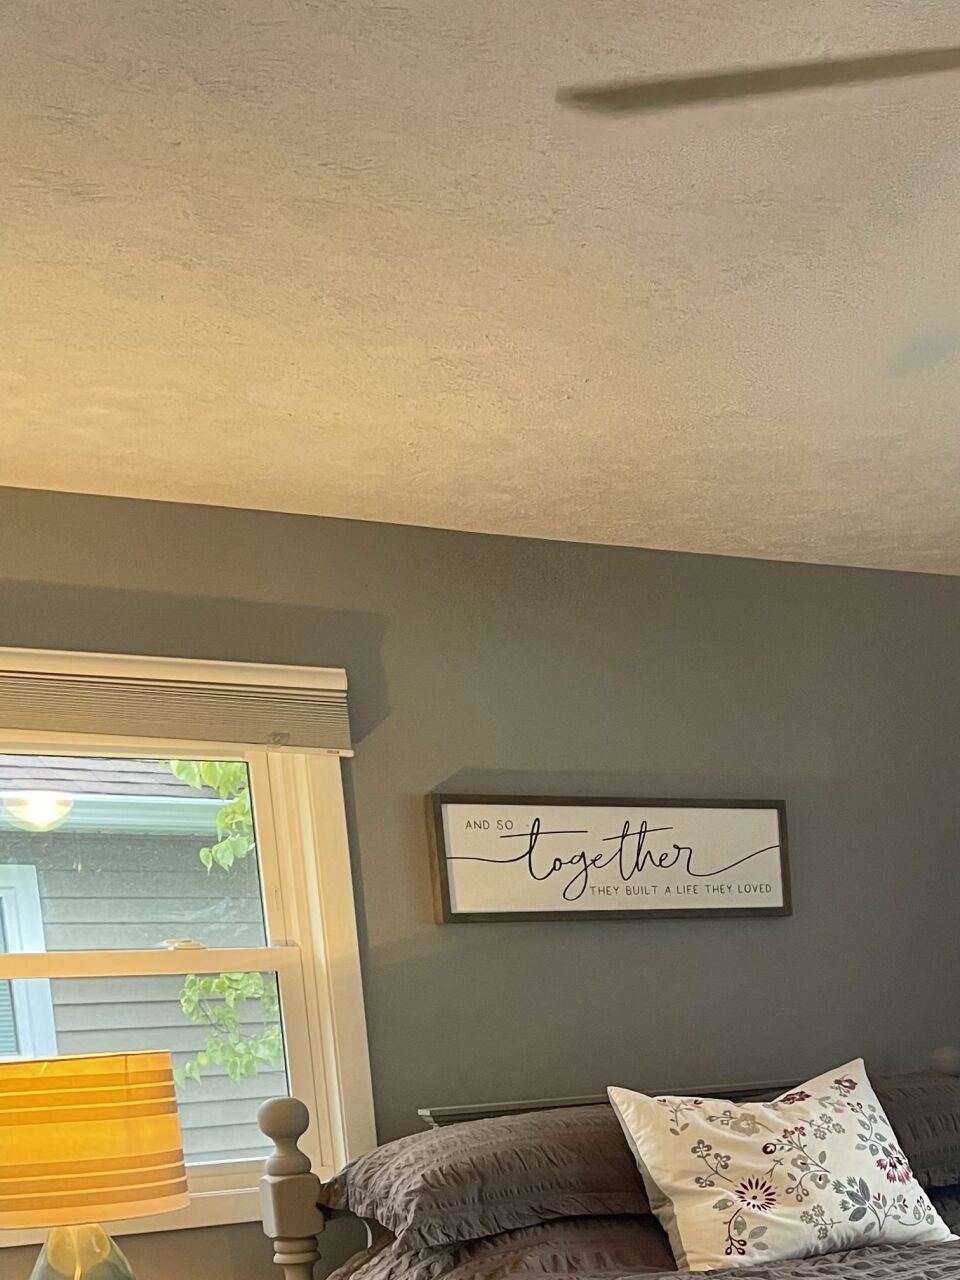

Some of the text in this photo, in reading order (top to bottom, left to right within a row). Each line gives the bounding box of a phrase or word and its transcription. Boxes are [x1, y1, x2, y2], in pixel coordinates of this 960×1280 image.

[465, 819, 514, 830] AND SO
[500, 817, 712, 901] together
[589, 883, 772, 896] THEY BUILT A LIFE THEY LOVED
